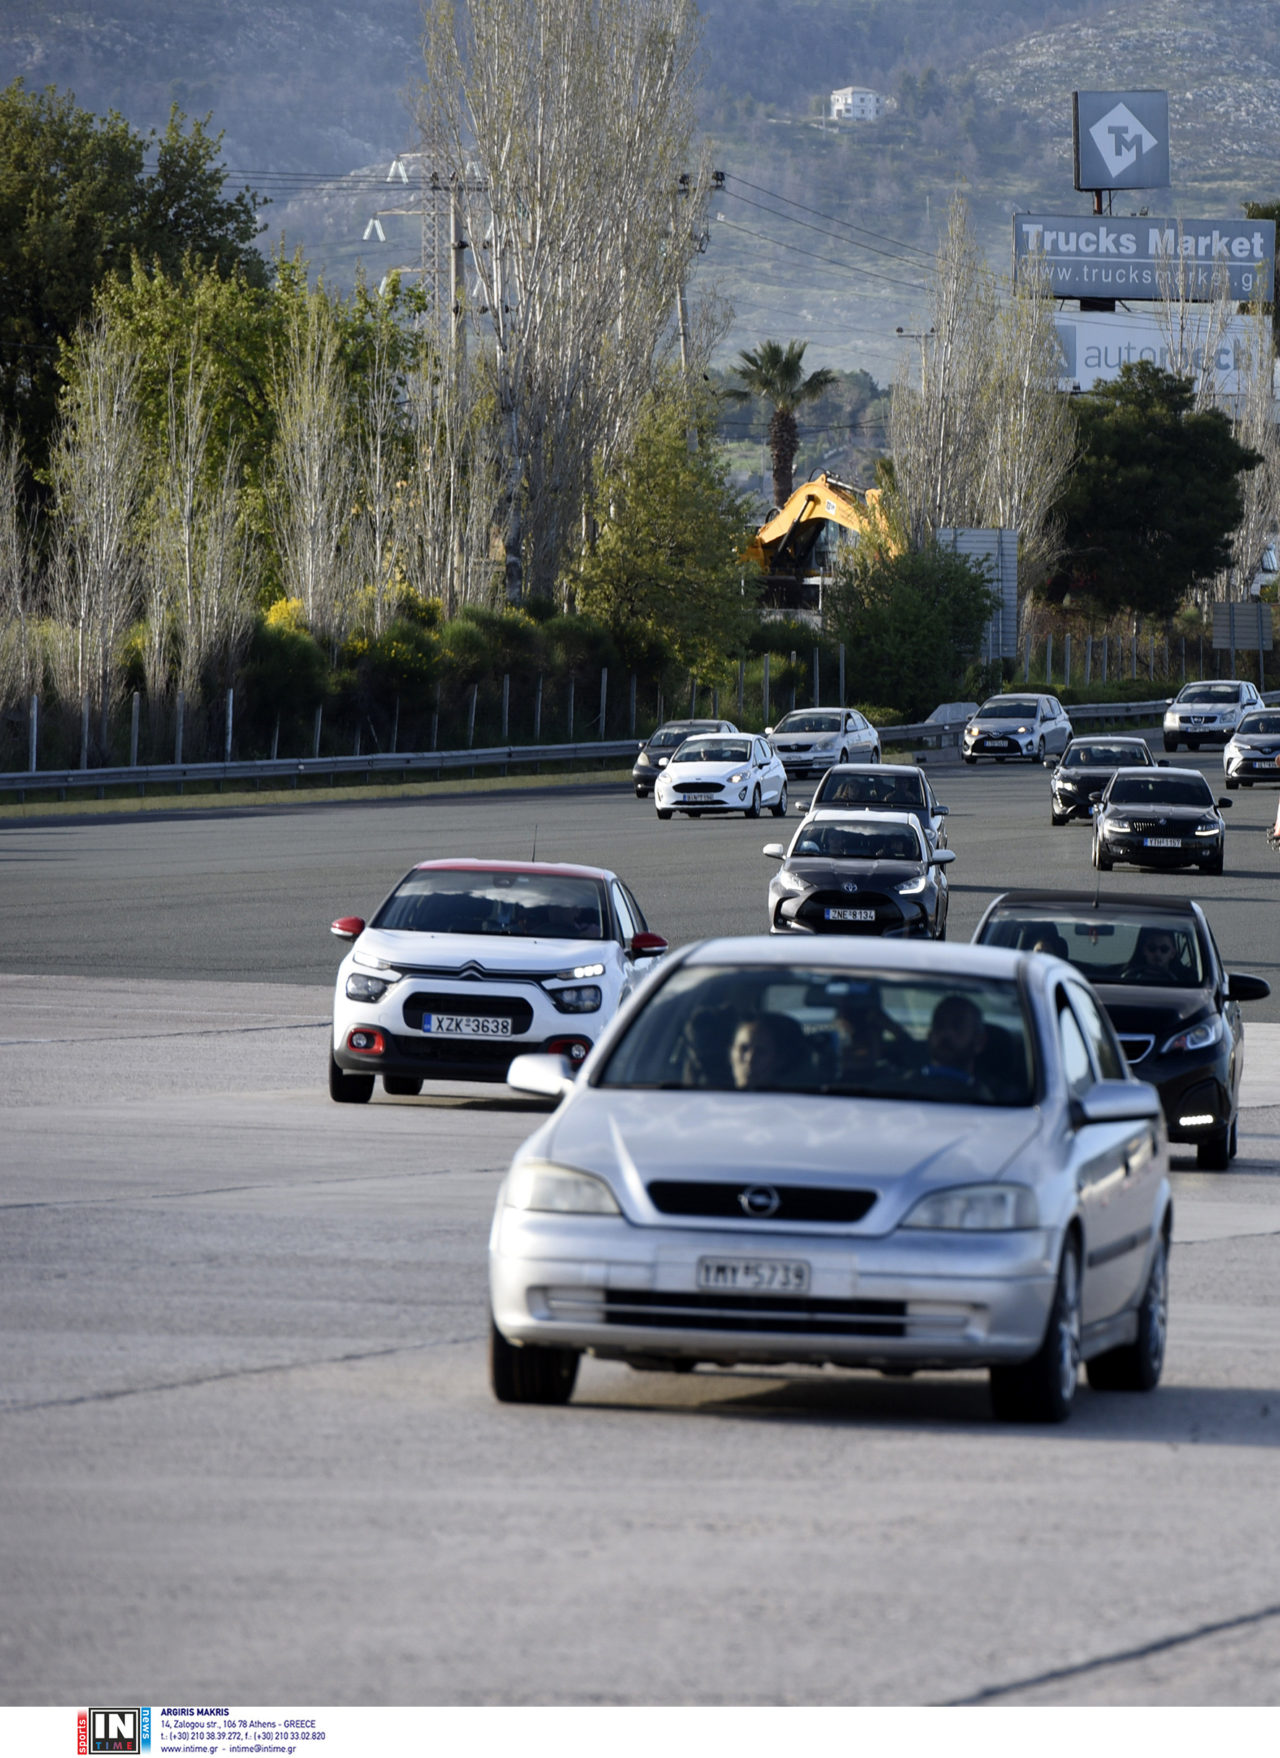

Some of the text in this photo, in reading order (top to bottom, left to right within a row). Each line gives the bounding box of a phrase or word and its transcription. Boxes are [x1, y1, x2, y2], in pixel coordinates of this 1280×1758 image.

[1108, 126, 1142, 160] TM
[1022, 224, 1264, 258] Trucks Market
[436, 1015, 510, 1034] XZK-3638
